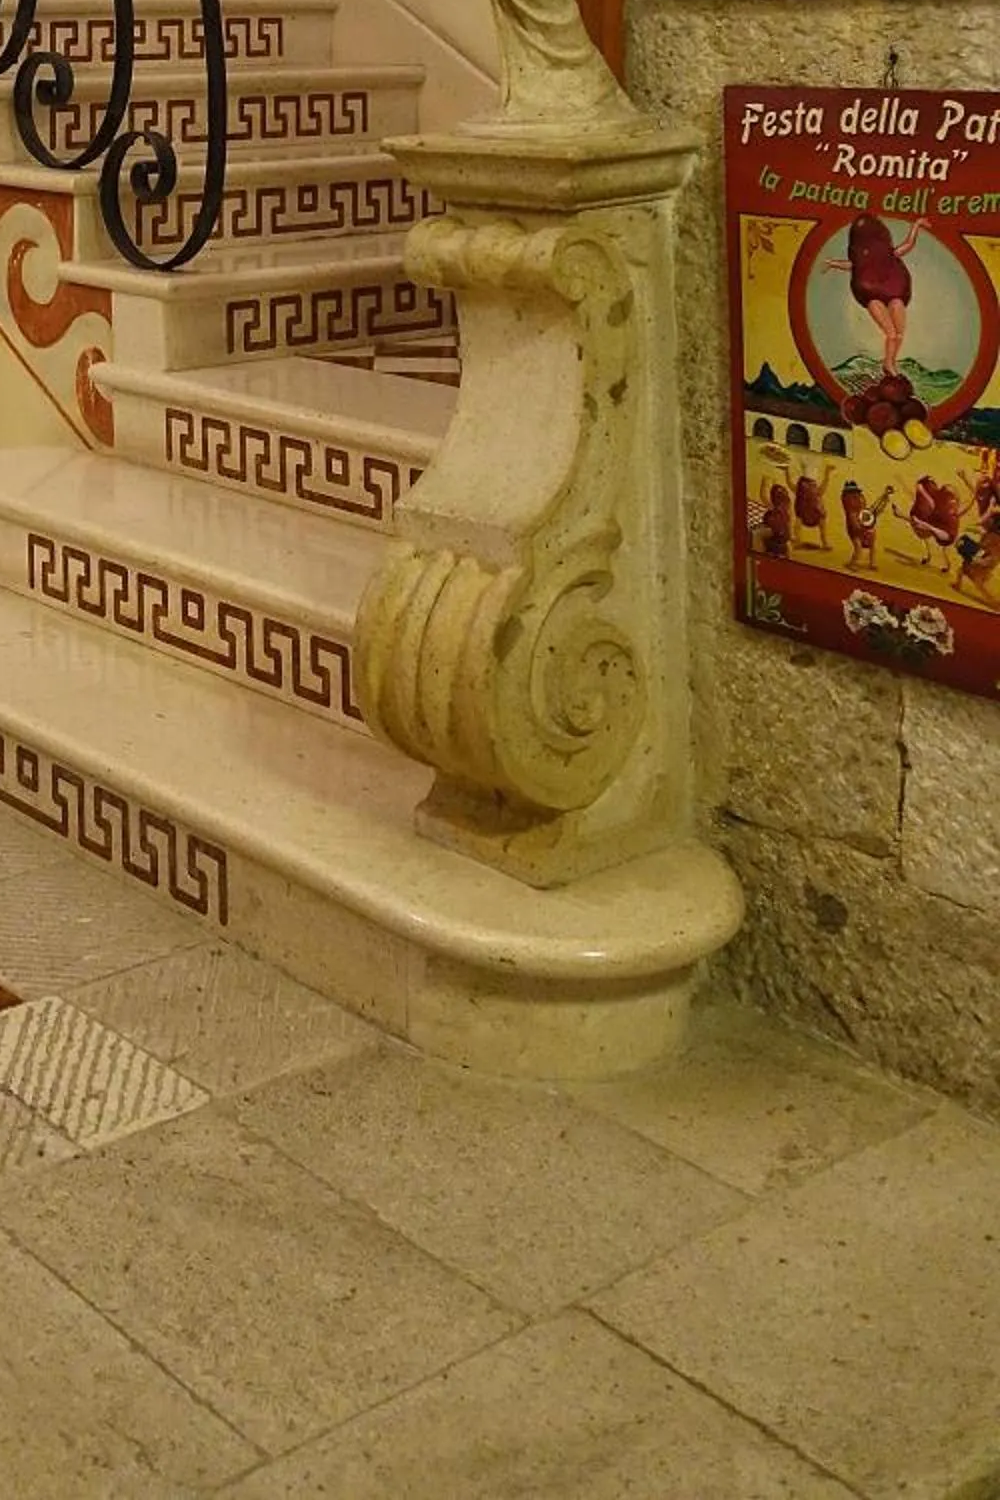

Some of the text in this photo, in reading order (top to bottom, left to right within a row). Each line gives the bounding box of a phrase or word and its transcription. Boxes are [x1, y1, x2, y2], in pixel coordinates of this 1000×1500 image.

[741, 102, 823, 145] Festa
[839, 97, 919, 135] della
[759, 164, 781, 191] la
[790, 179, 869, 209] patata
